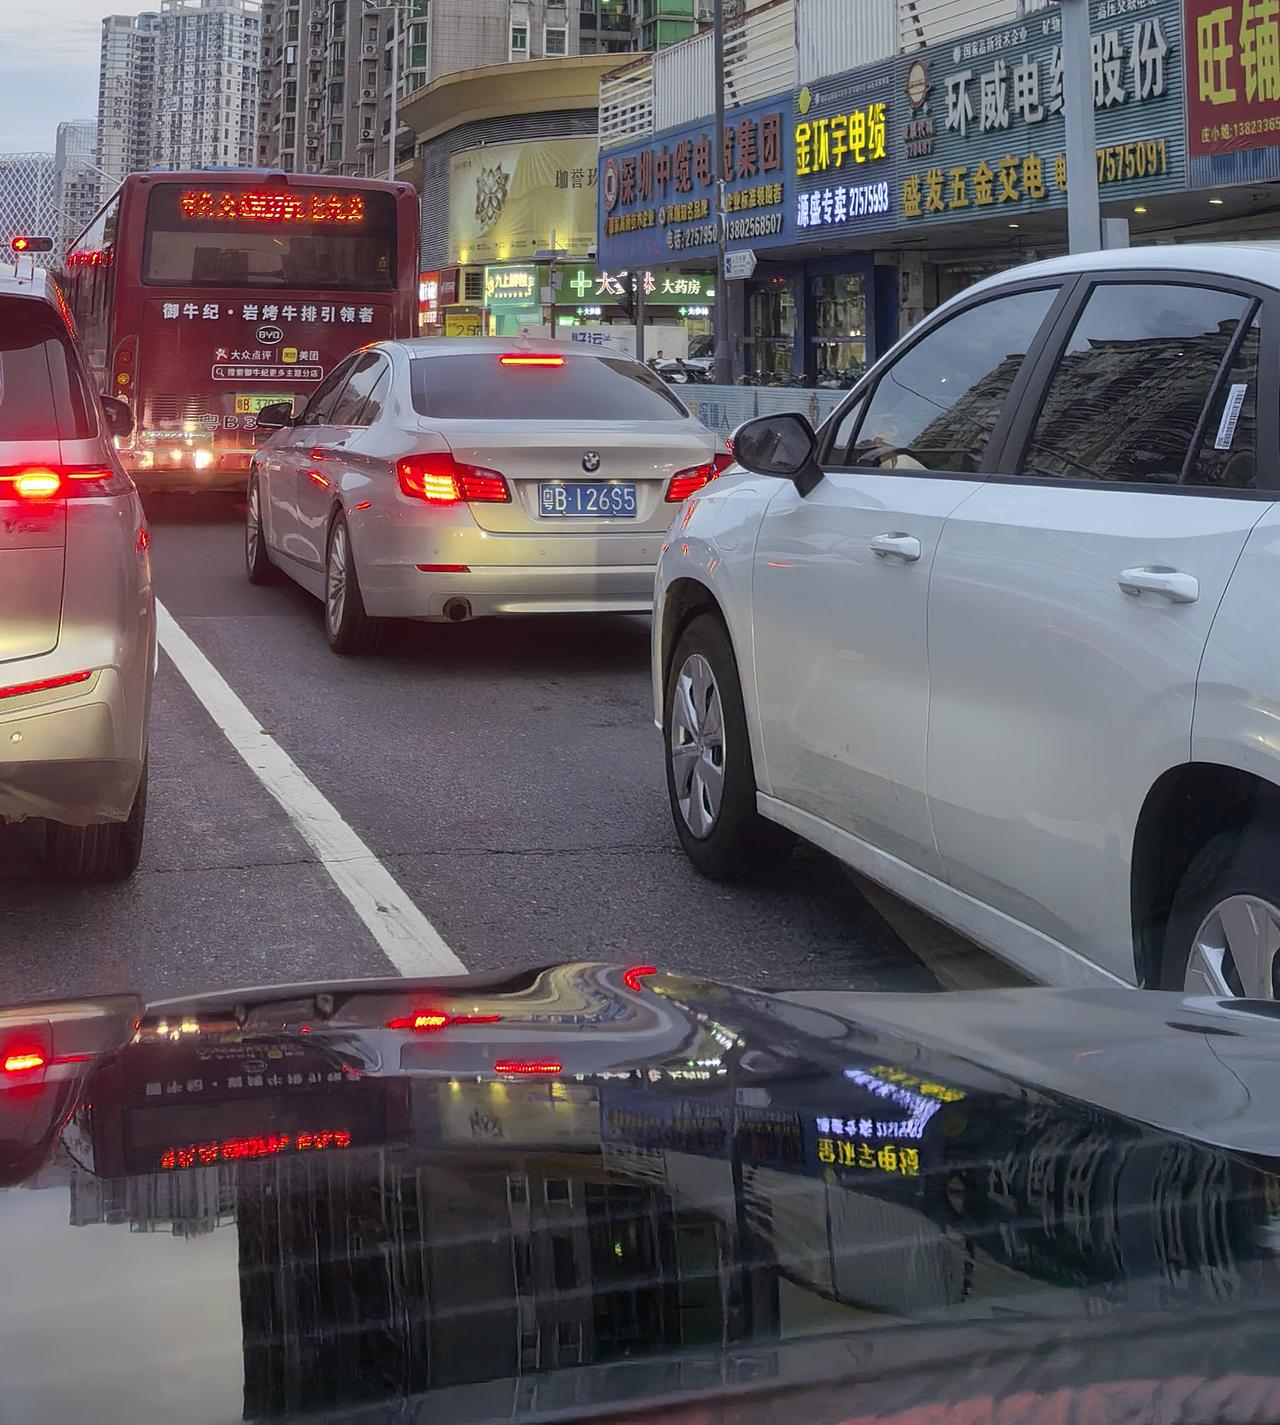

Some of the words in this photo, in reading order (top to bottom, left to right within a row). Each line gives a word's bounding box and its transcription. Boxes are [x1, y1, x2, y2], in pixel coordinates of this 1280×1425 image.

[963, 27, 1028, 60] 国家高新技术企业
[795, 102, 887, 176] 金环宇电缆
[903, 152, 1046, 217] 盛发五金交电
[797, 186, 847, 227] 源盛专卖
[726, 213, 782, 241] 13802568507
[661, 279, 701, 294] 大药房
[258, 330, 280, 340] BYD
[230, 350, 272, 361] 大众点评
[299, 350, 319, 361] 美团
